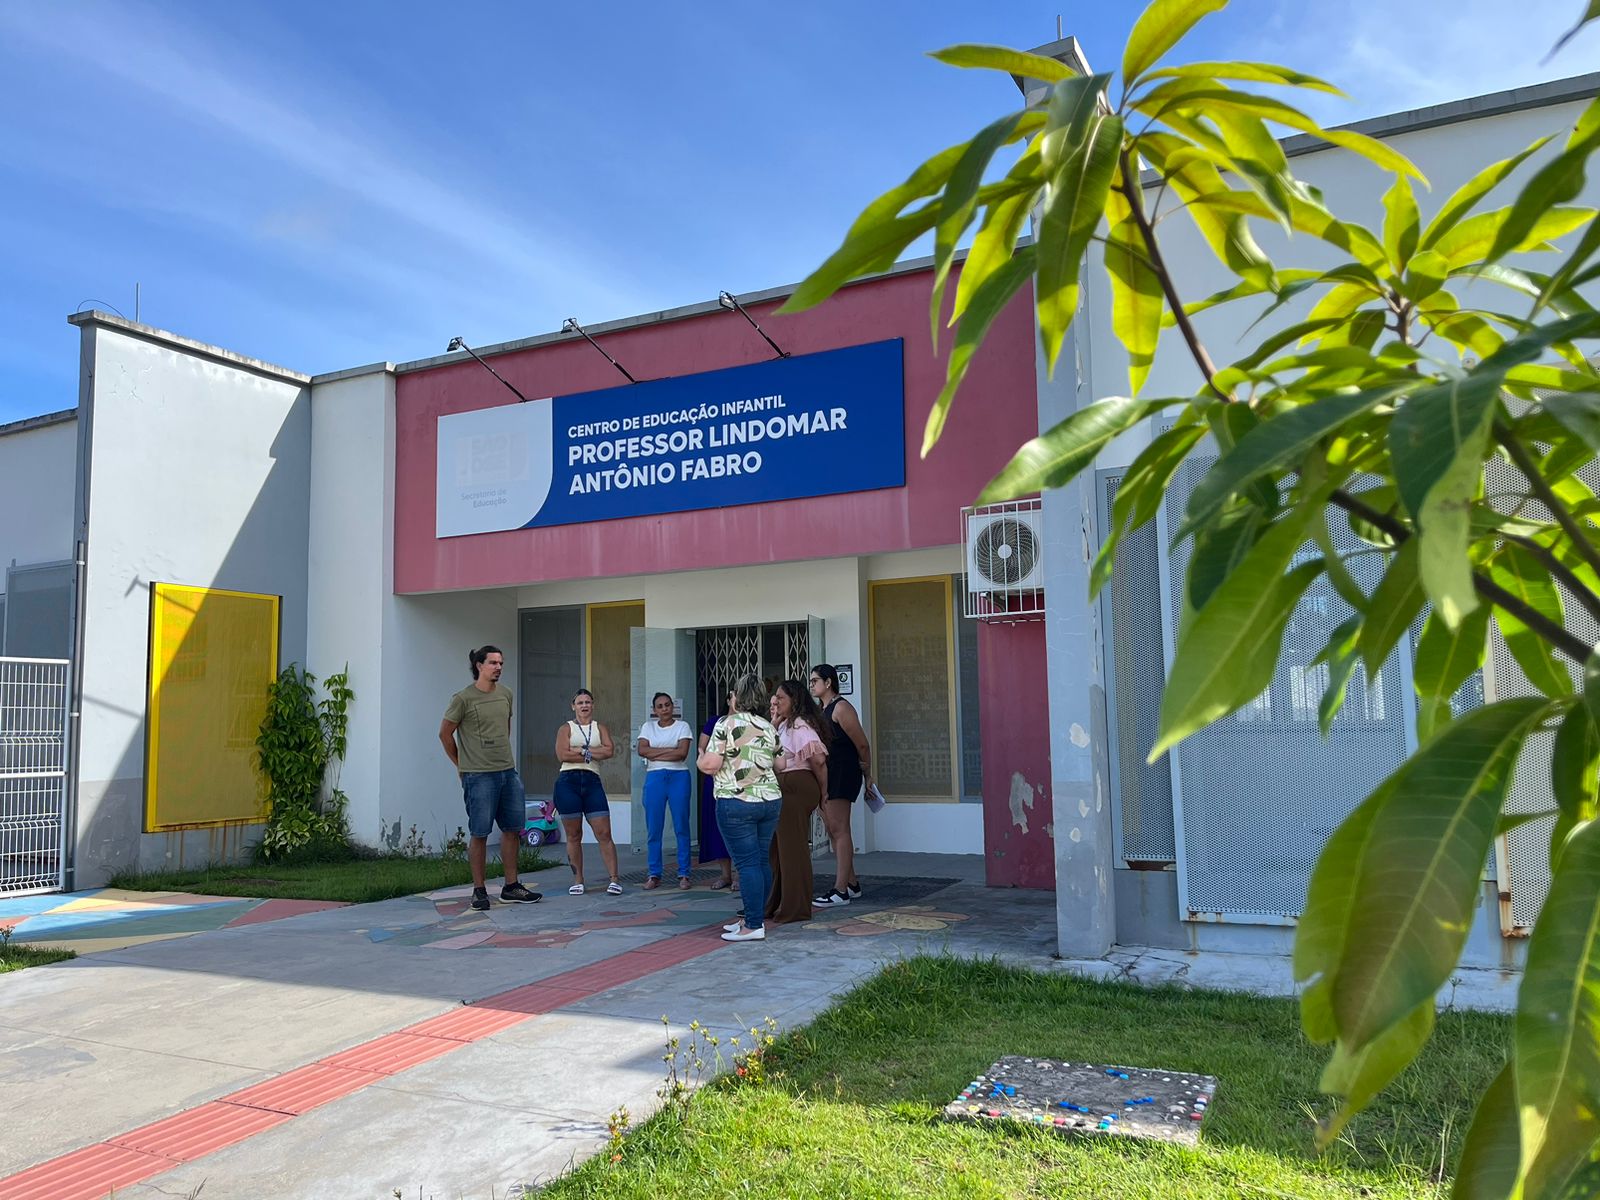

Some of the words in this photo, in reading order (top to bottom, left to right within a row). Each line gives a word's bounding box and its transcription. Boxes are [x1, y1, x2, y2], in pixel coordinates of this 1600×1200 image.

[568, 424, 620, 439] CENTRO
[622, 416, 640, 431] DE
[642, 403, 719, 425] EDUCAÇÃO
[721, 394, 786, 416] INFANTIL
[568, 428, 704, 466] PROFESSOR
[709, 407, 847, 448] LINDOMAR
[569, 462, 676, 495] ANTÔNIO
[681, 451, 762, 482] FABRO
